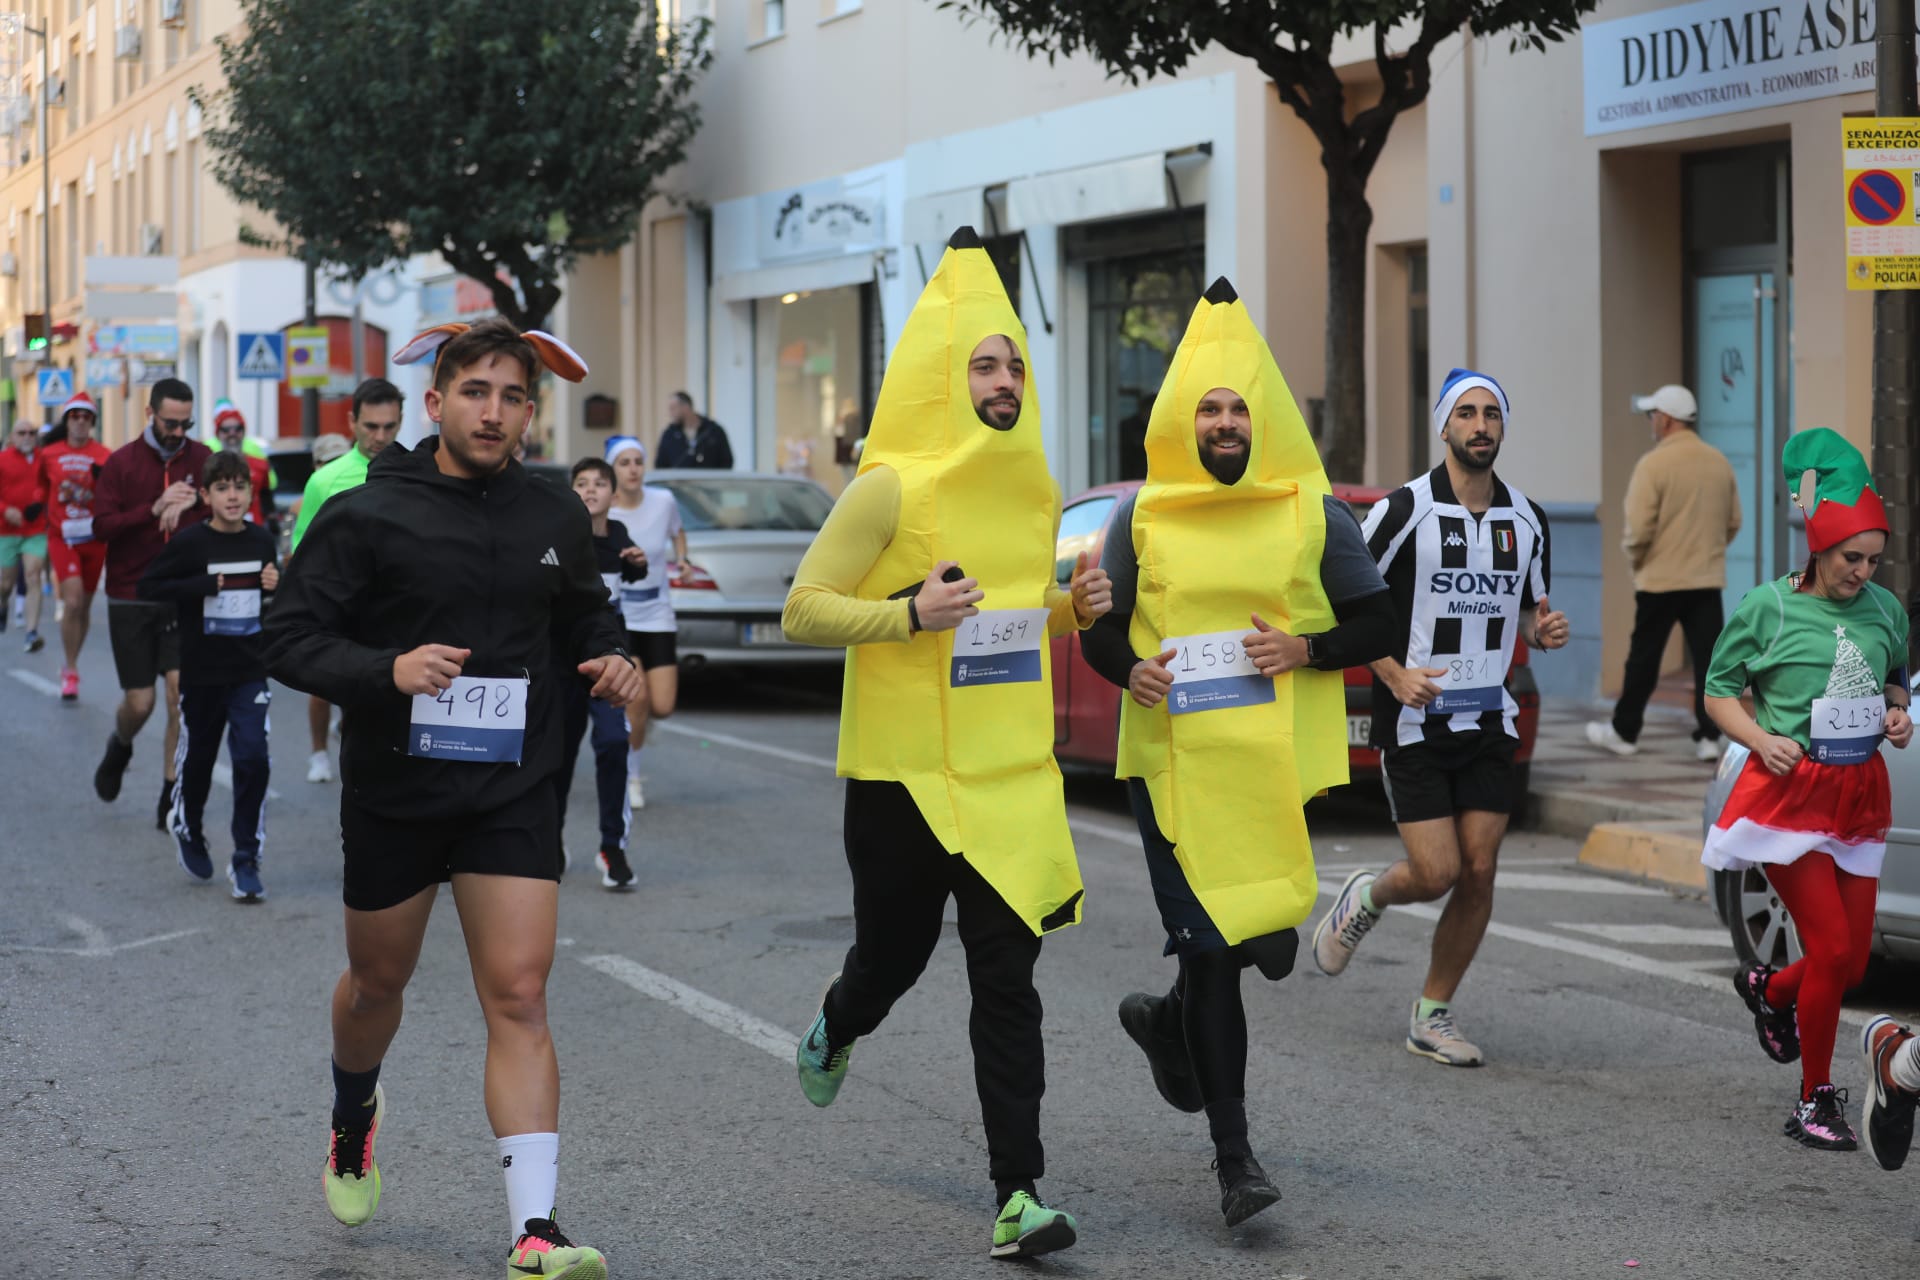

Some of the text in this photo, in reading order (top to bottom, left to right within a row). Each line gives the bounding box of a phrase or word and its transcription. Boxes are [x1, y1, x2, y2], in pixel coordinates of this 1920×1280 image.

[1621, 0, 1876, 88] DIDYME ASE
[1656, 82, 1752, 113] ADMINISTRATIVA
[1762, 66, 1840, 95] ECONOMISTA
[1430, 572, 1521, 596] SONY
[1447, 601, 1502, 615] MiniDisc
[970, 619, 1029, 646] 1589
[1180, 640, 1247, 673] 158
[1449, 657, 1489, 682] 881
[436, 684, 511, 719] 498
[1828, 704, 1883, 731] 2139
